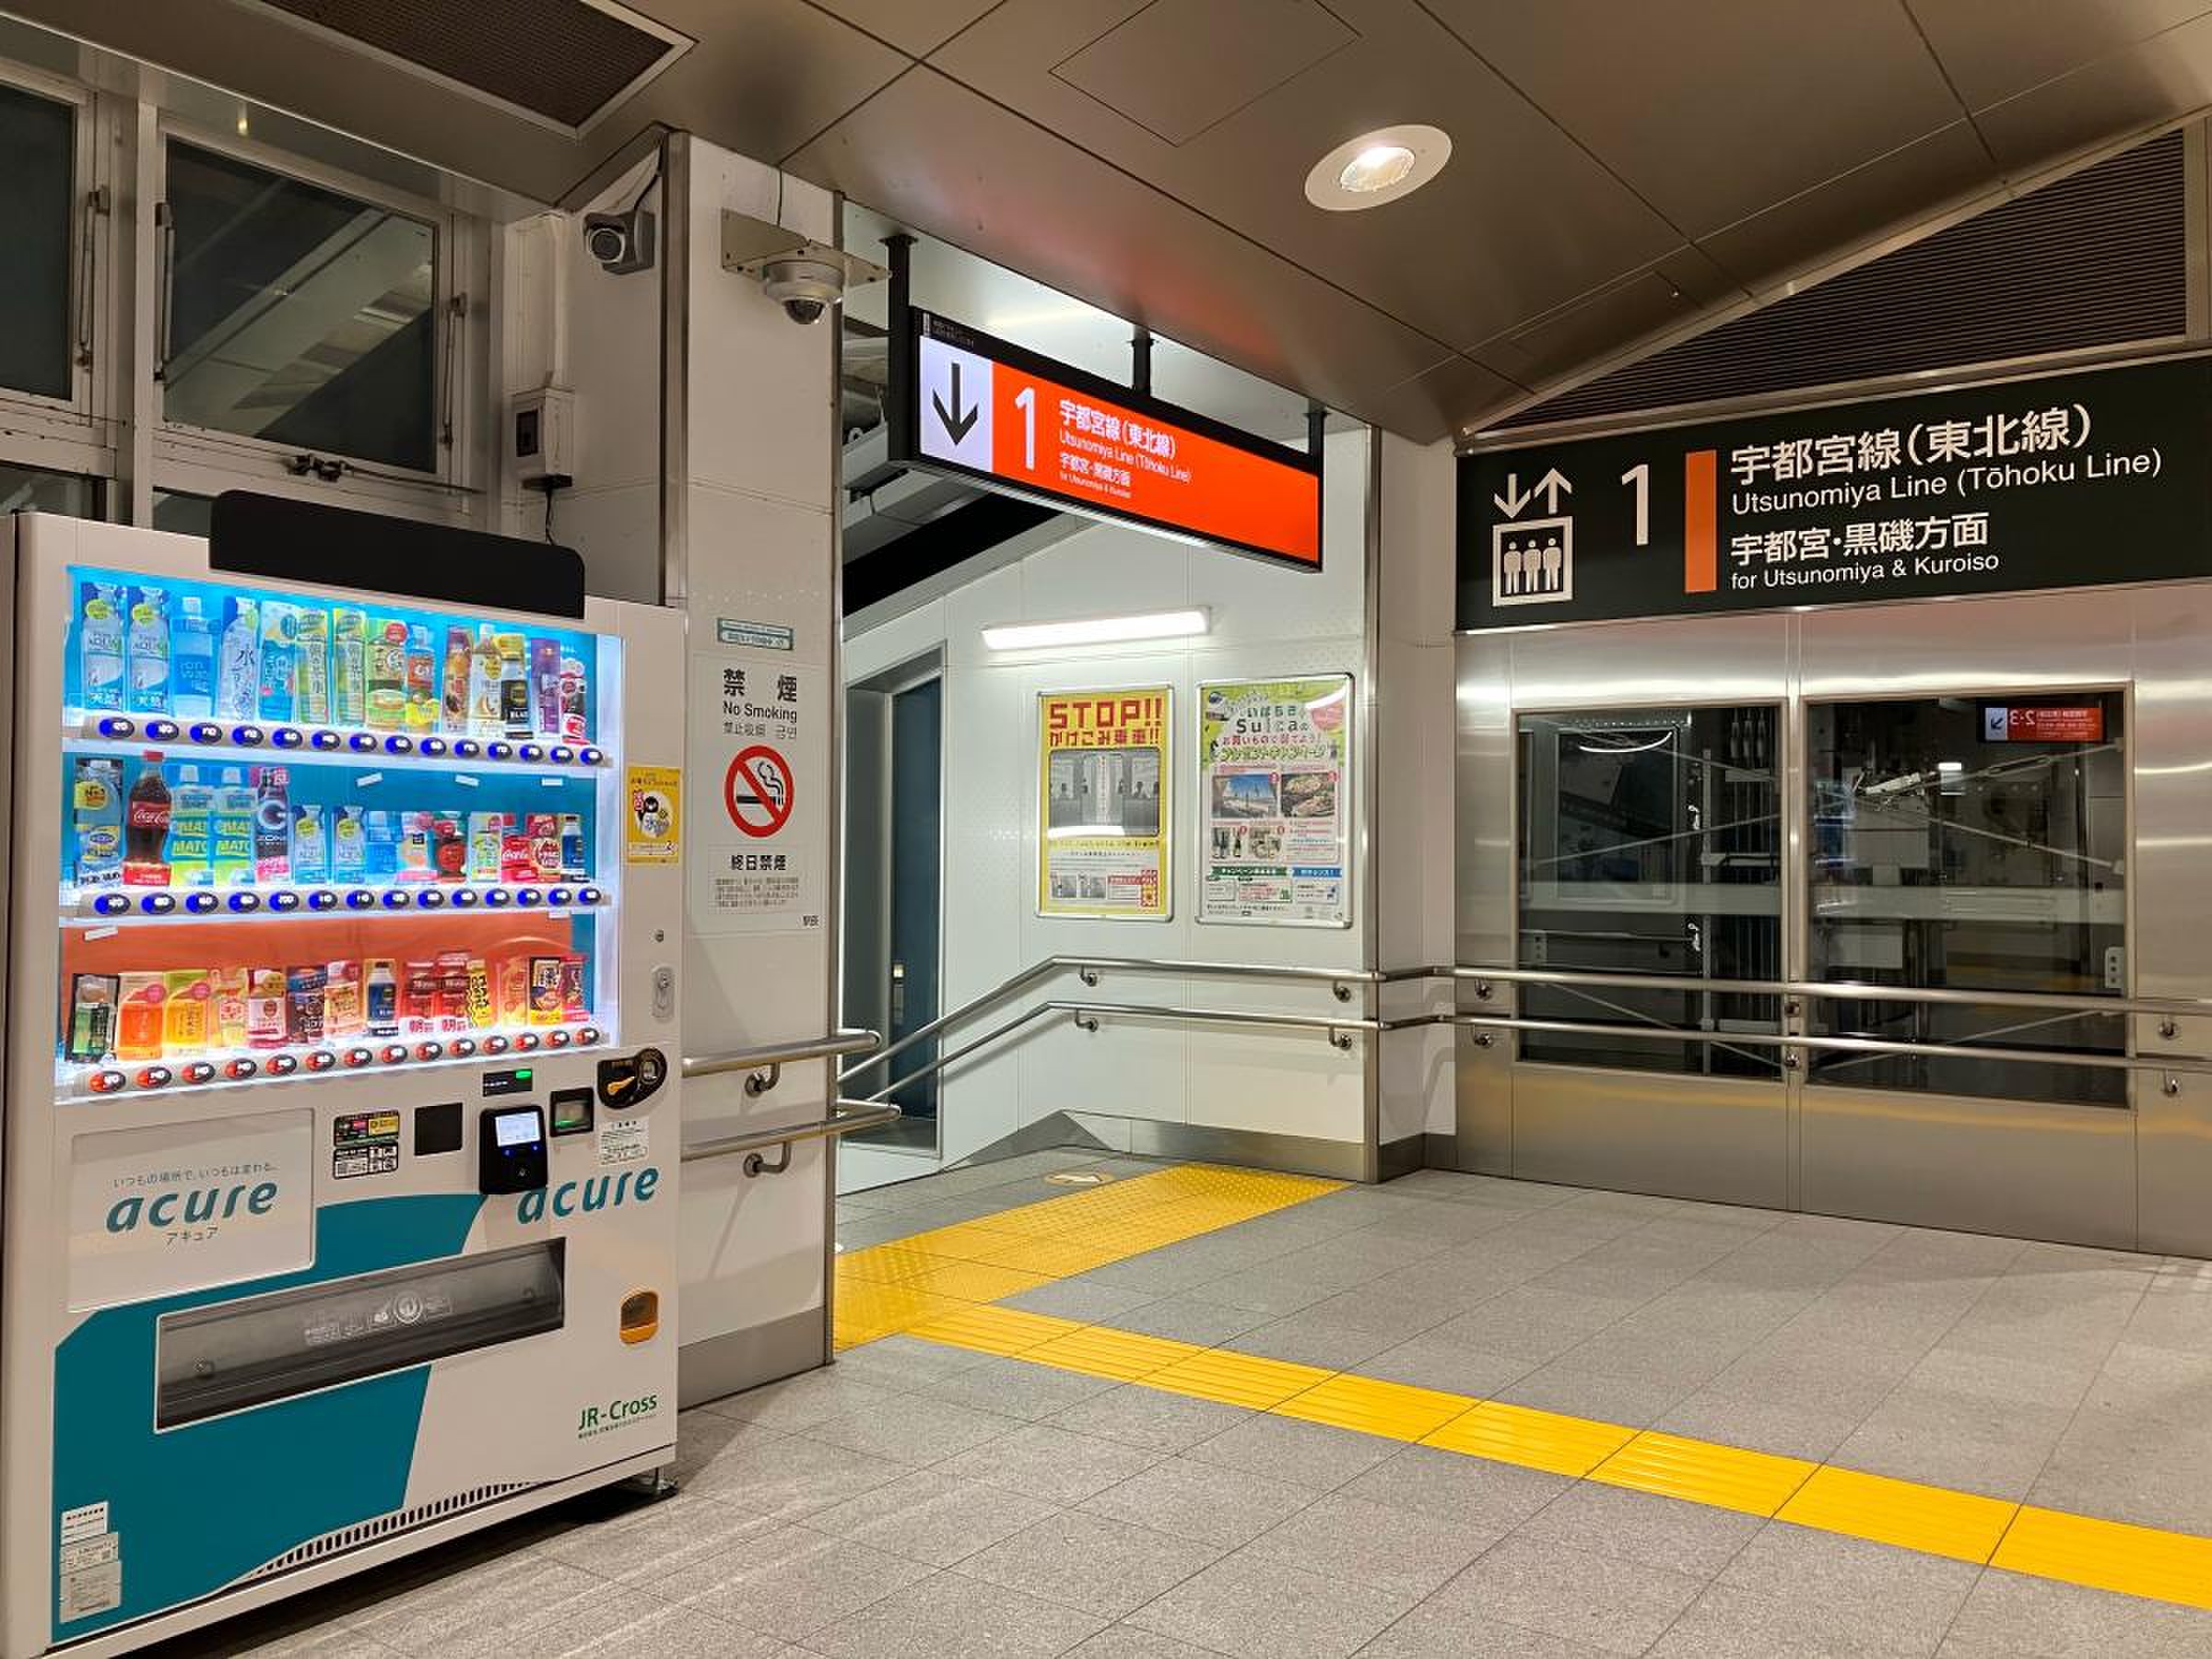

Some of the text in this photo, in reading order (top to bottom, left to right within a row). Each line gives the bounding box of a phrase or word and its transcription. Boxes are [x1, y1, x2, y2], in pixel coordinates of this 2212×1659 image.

[1015, 386, 1035, 472] 1
[1060, 428, 1112, 459] Utsunomiya
[1113, 446, 1133, 465] Line
[1730, 403, 2091, 487] 宇都宮線(東北線)
[1621, 463, 1649, 547] 1
[1731, 446, 2162, 516] Utsunomiya Line (Tōhoku Line)
[1731, 552, 2000, 590] for Utsunomiya & Kuroiso
[723, 701, 797, 724] No Smoking
[1049, 698, 1162, 729] STOP!!
[105, 1181, 278, 1234] acure
[517, 1167, 659, 1225] acure
[578, 1394, 658, 1430] JR-Cross
